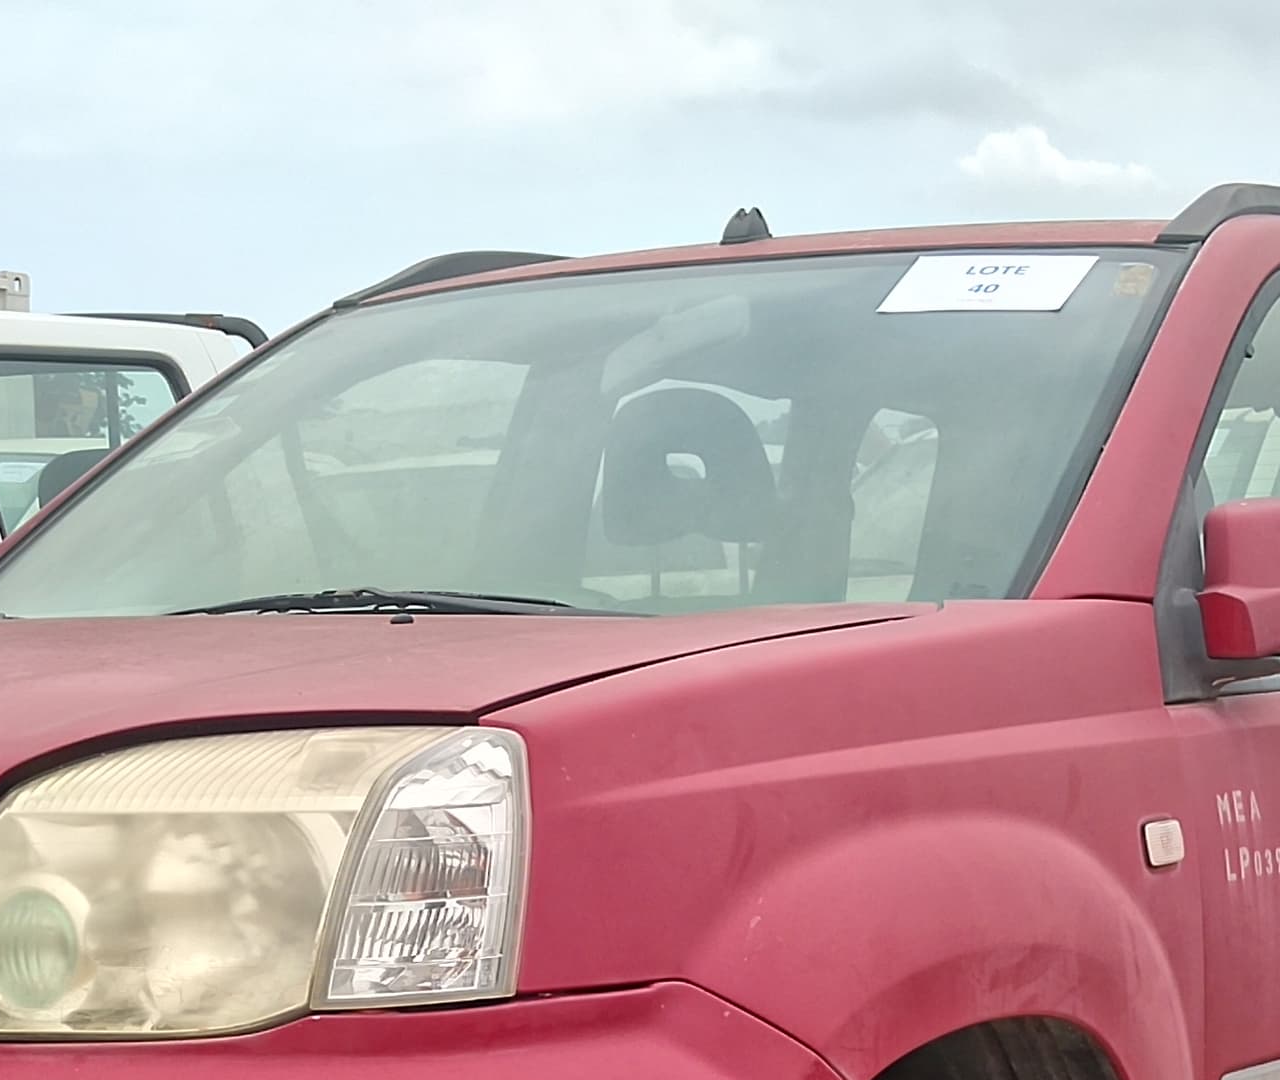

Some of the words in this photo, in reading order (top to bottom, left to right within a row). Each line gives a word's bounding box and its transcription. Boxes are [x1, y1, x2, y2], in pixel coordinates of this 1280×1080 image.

[965, 265, 1030, 276] LOTE
[967, 283, 1000, 294] 40
[1216, 789, 1262, 825] MEA
